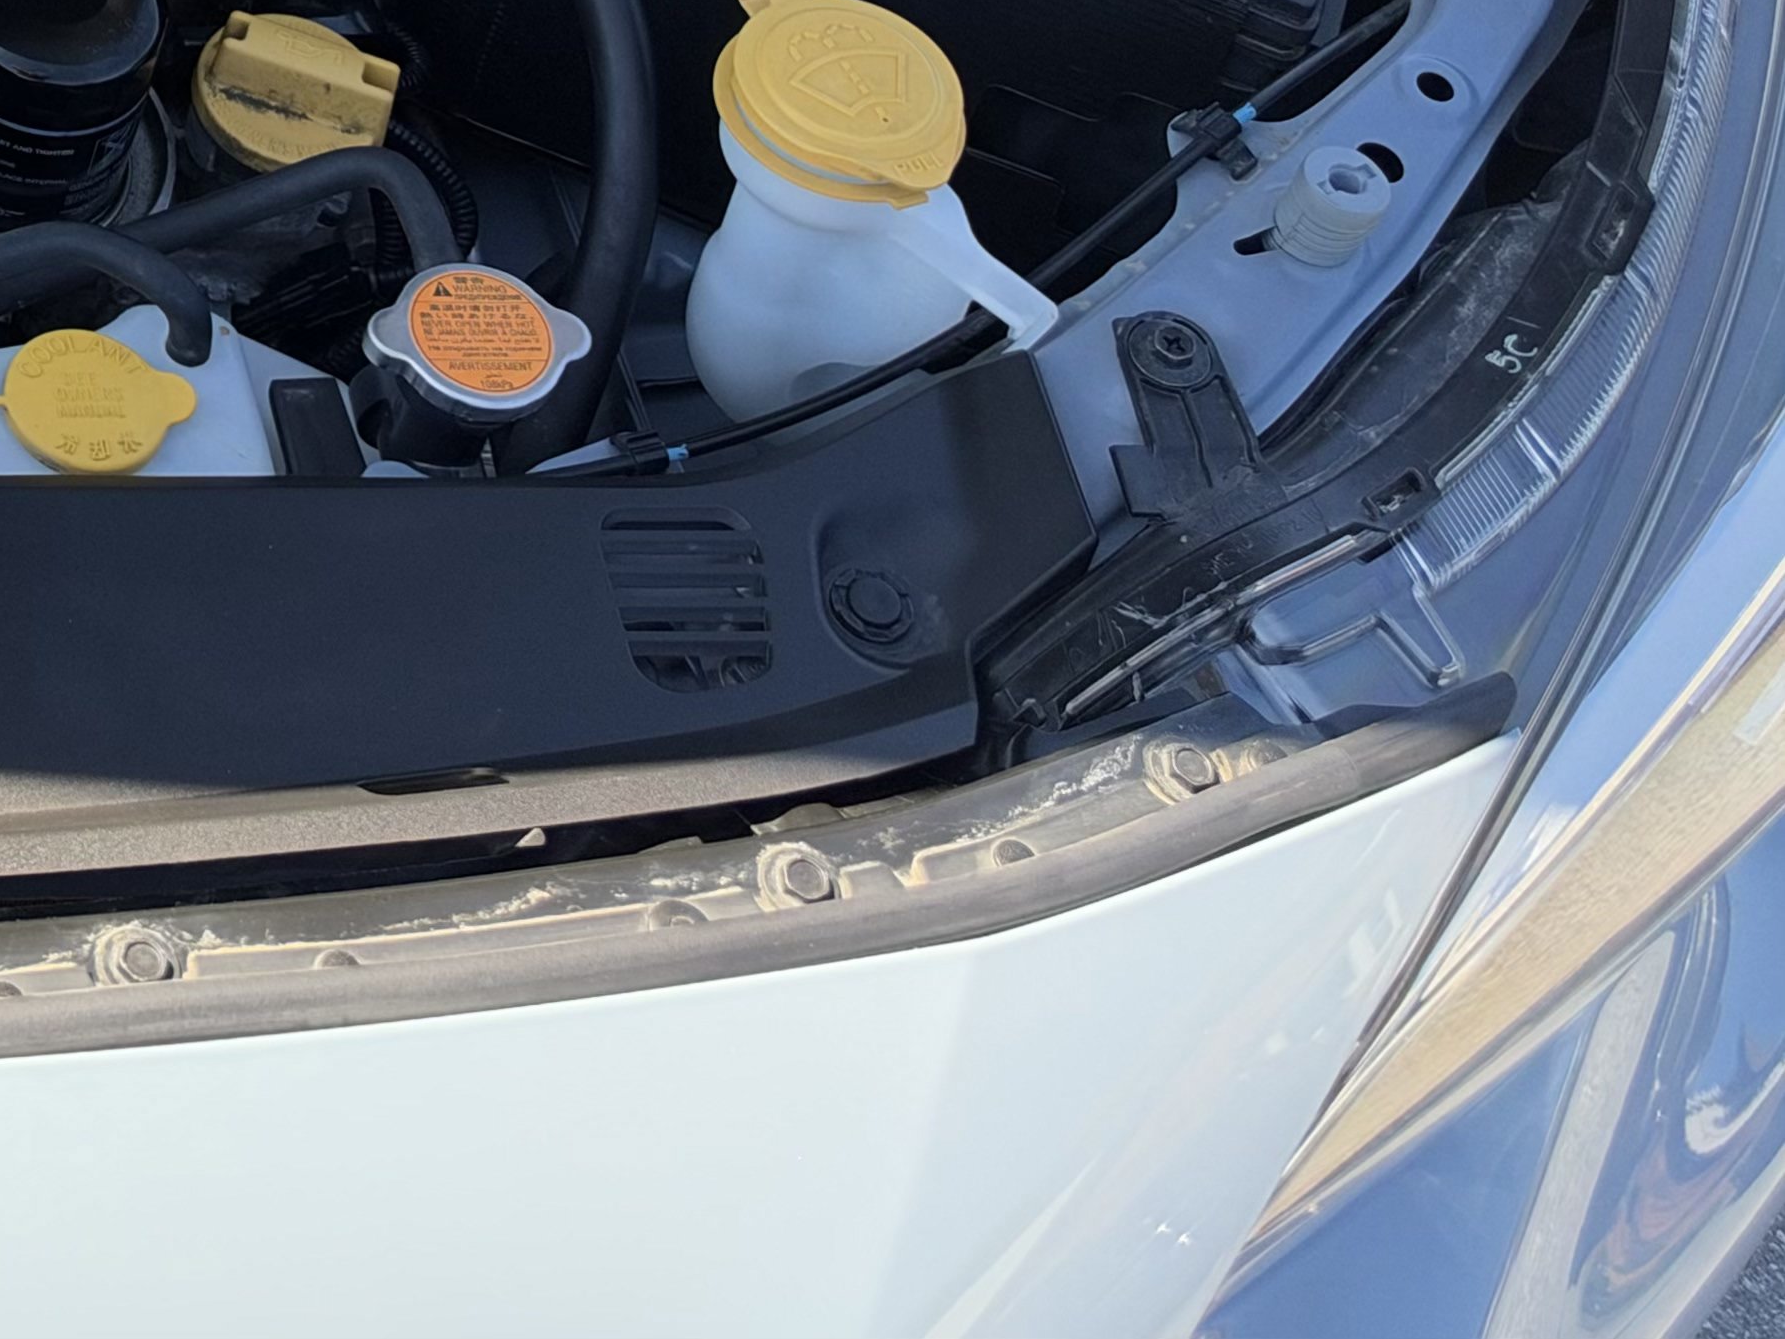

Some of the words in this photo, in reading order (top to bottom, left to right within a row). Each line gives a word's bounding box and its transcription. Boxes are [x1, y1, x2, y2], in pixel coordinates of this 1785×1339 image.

[452, 285, 507, 294] WARNING
[455, 320, 480, 328] OPEN
[17, 335, 150, 379] COOLANT
[449, 361, 532, 371] AVERTISSEMENT
